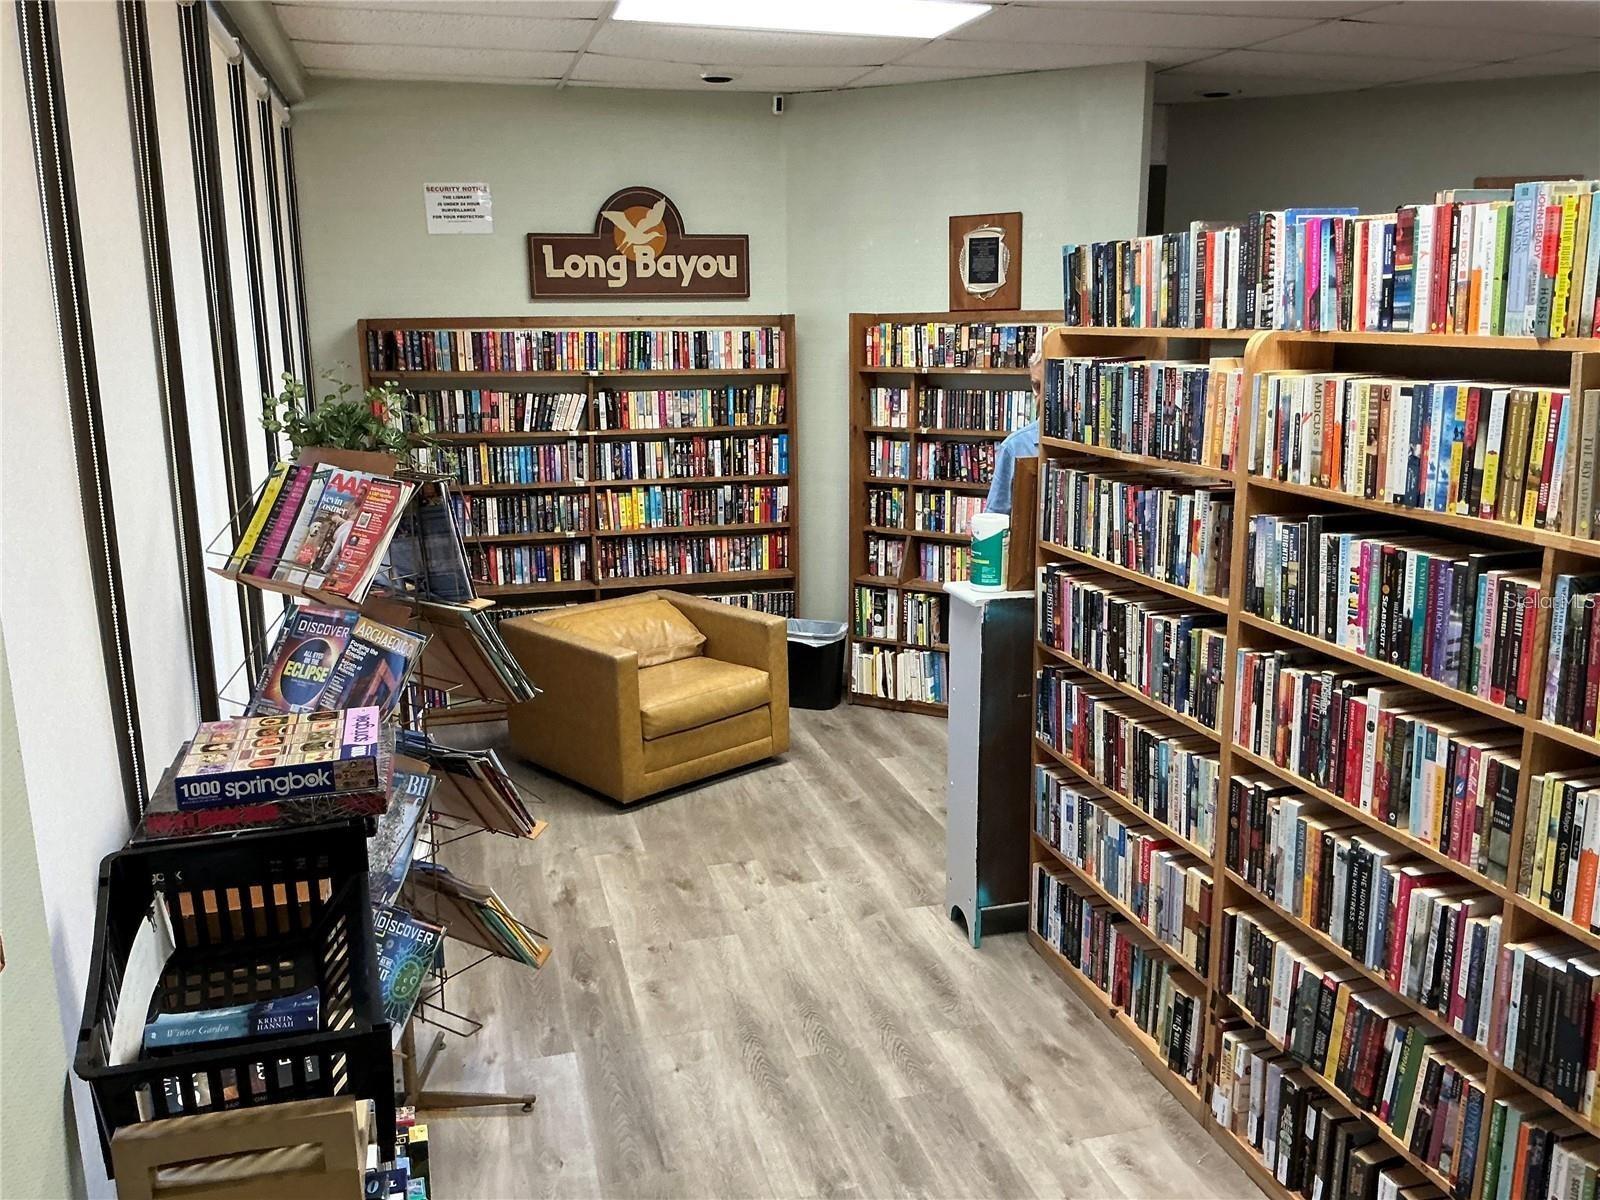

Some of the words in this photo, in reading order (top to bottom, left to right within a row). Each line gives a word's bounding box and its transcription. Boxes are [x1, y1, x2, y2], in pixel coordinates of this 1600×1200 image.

[542, 245, 628, 288] Long
[634, 246, 738, 287] Bayou
[1537, 288, 1549, 326] HORSE
[1313, 382, 1322, 436] MEDICUS
[1350, 566, 1360, 594] THE
[1347, 598, 1360, 626] NIX
[1380, 595, 1388, 647] SEABISCUIT
[298, 620, 350, 638] DISCOVER
[284, 660, 330, 682] ECLIPSE
[180, 780, 221, 798] 1000
[224, 768, 332, 800] springbok
[1349, 879, 1358, 922] HUNTRESS
[1357, 888, 1367, 931] HUNTRESS
[376, 916, 434, 945] DISCOVER
[167, 1028, 196, 1038] Winter
[198, 1024, 230, 1035] Garden
[257, 1022, 294, 1031] HANNAH
[258, 1015, 294, 1024] KRISTIN
